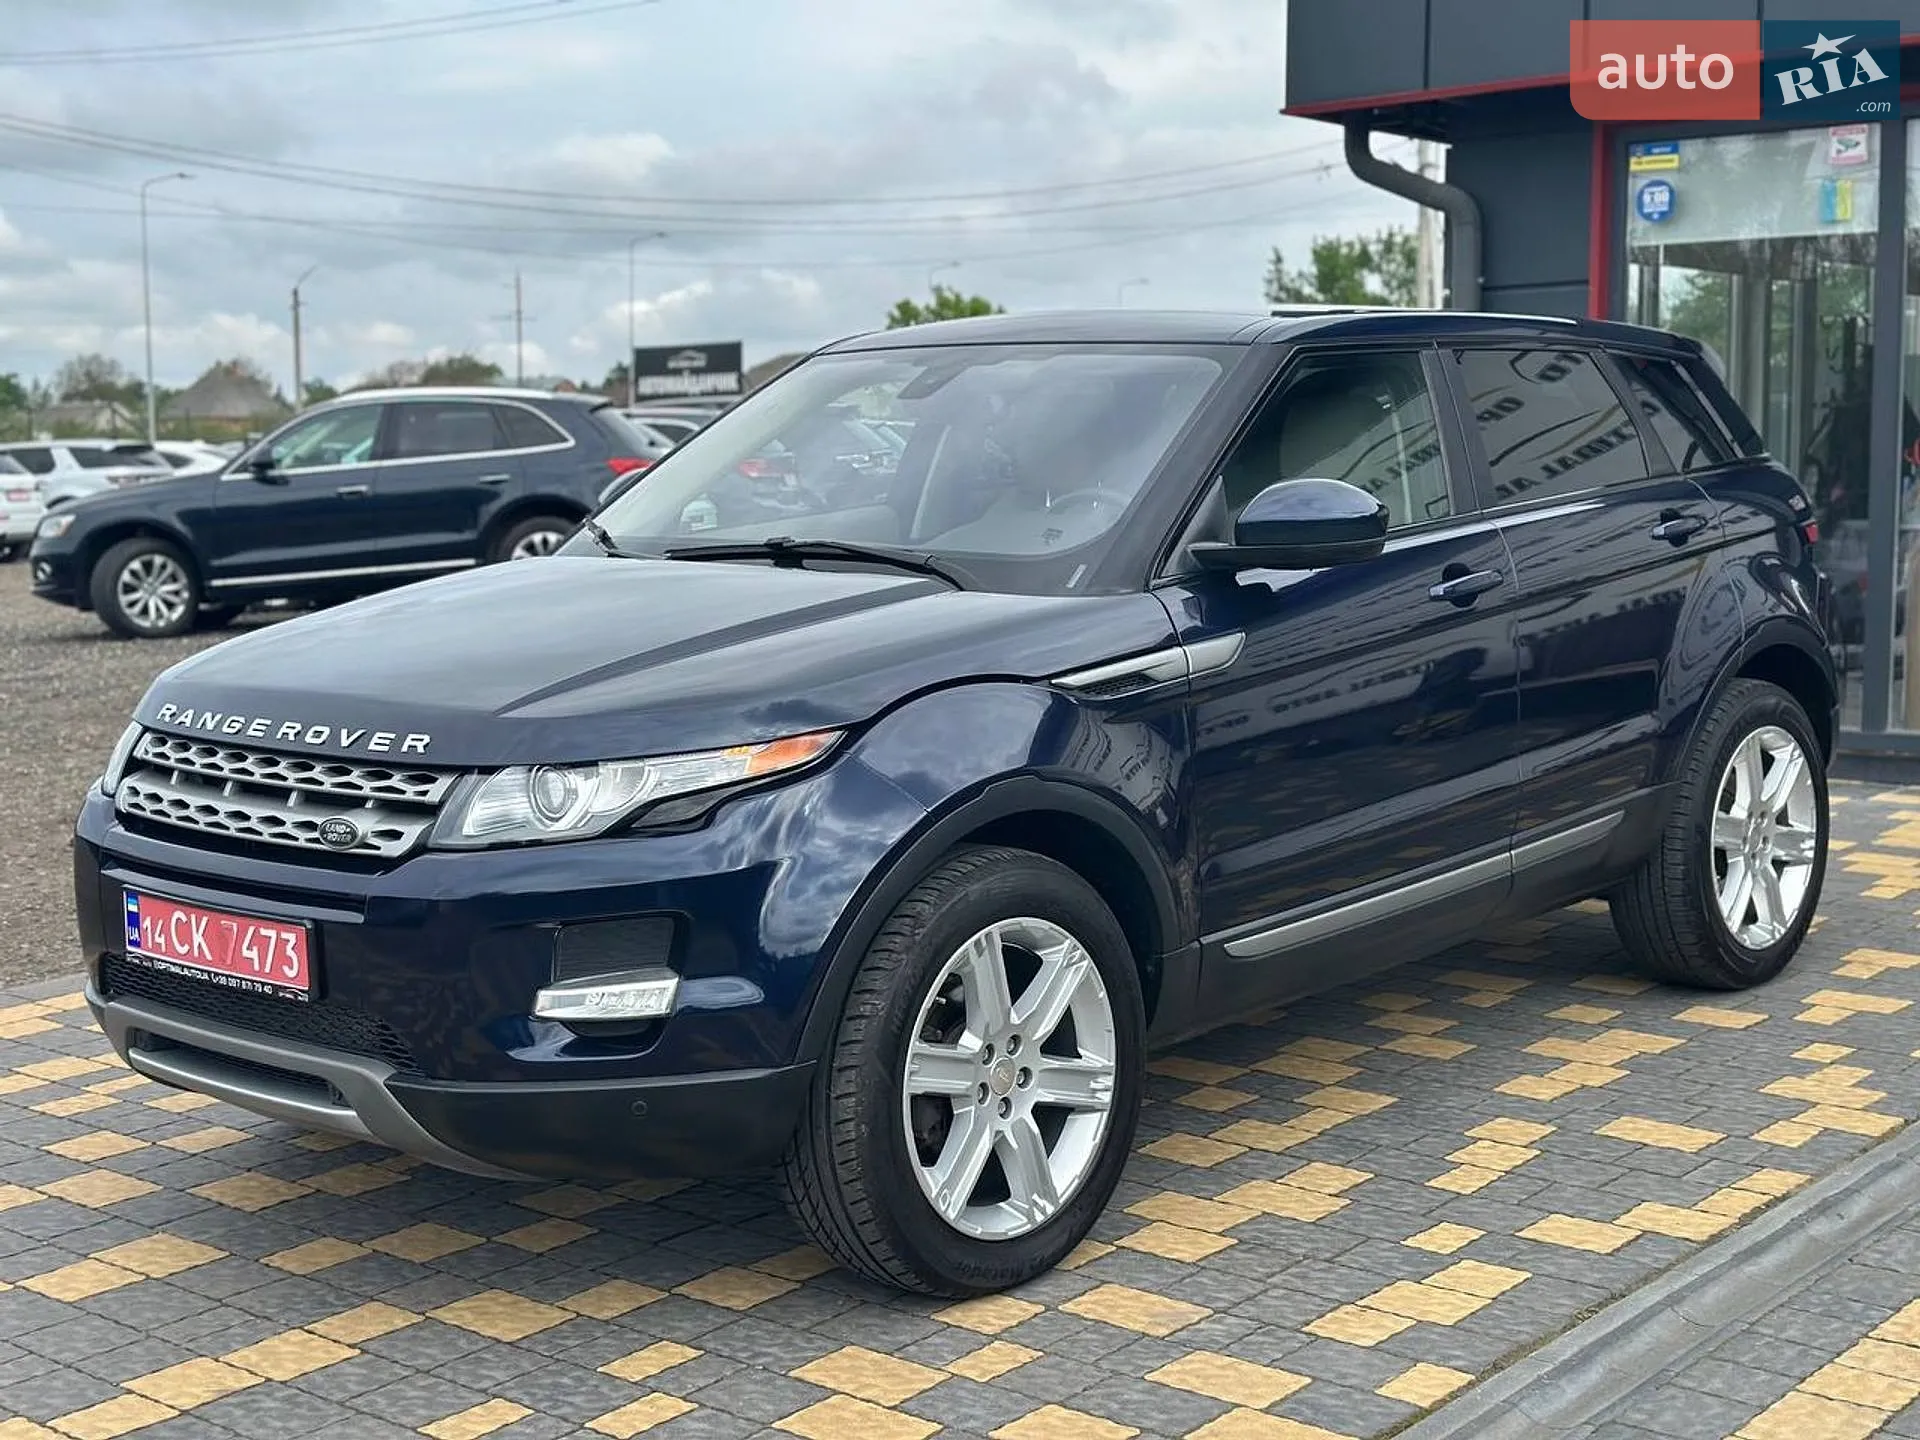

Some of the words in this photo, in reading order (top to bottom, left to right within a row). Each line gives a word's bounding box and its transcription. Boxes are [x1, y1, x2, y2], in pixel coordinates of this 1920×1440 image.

[157, 703, 272, 738] RANGE
[276, 720, 431, 754] ROVER
[129, 927, 141, 942] UA
[142, 915, 167, 952] 14
[169, 910, 213, 962] CK
[220, 920, 299, 979] 7473
